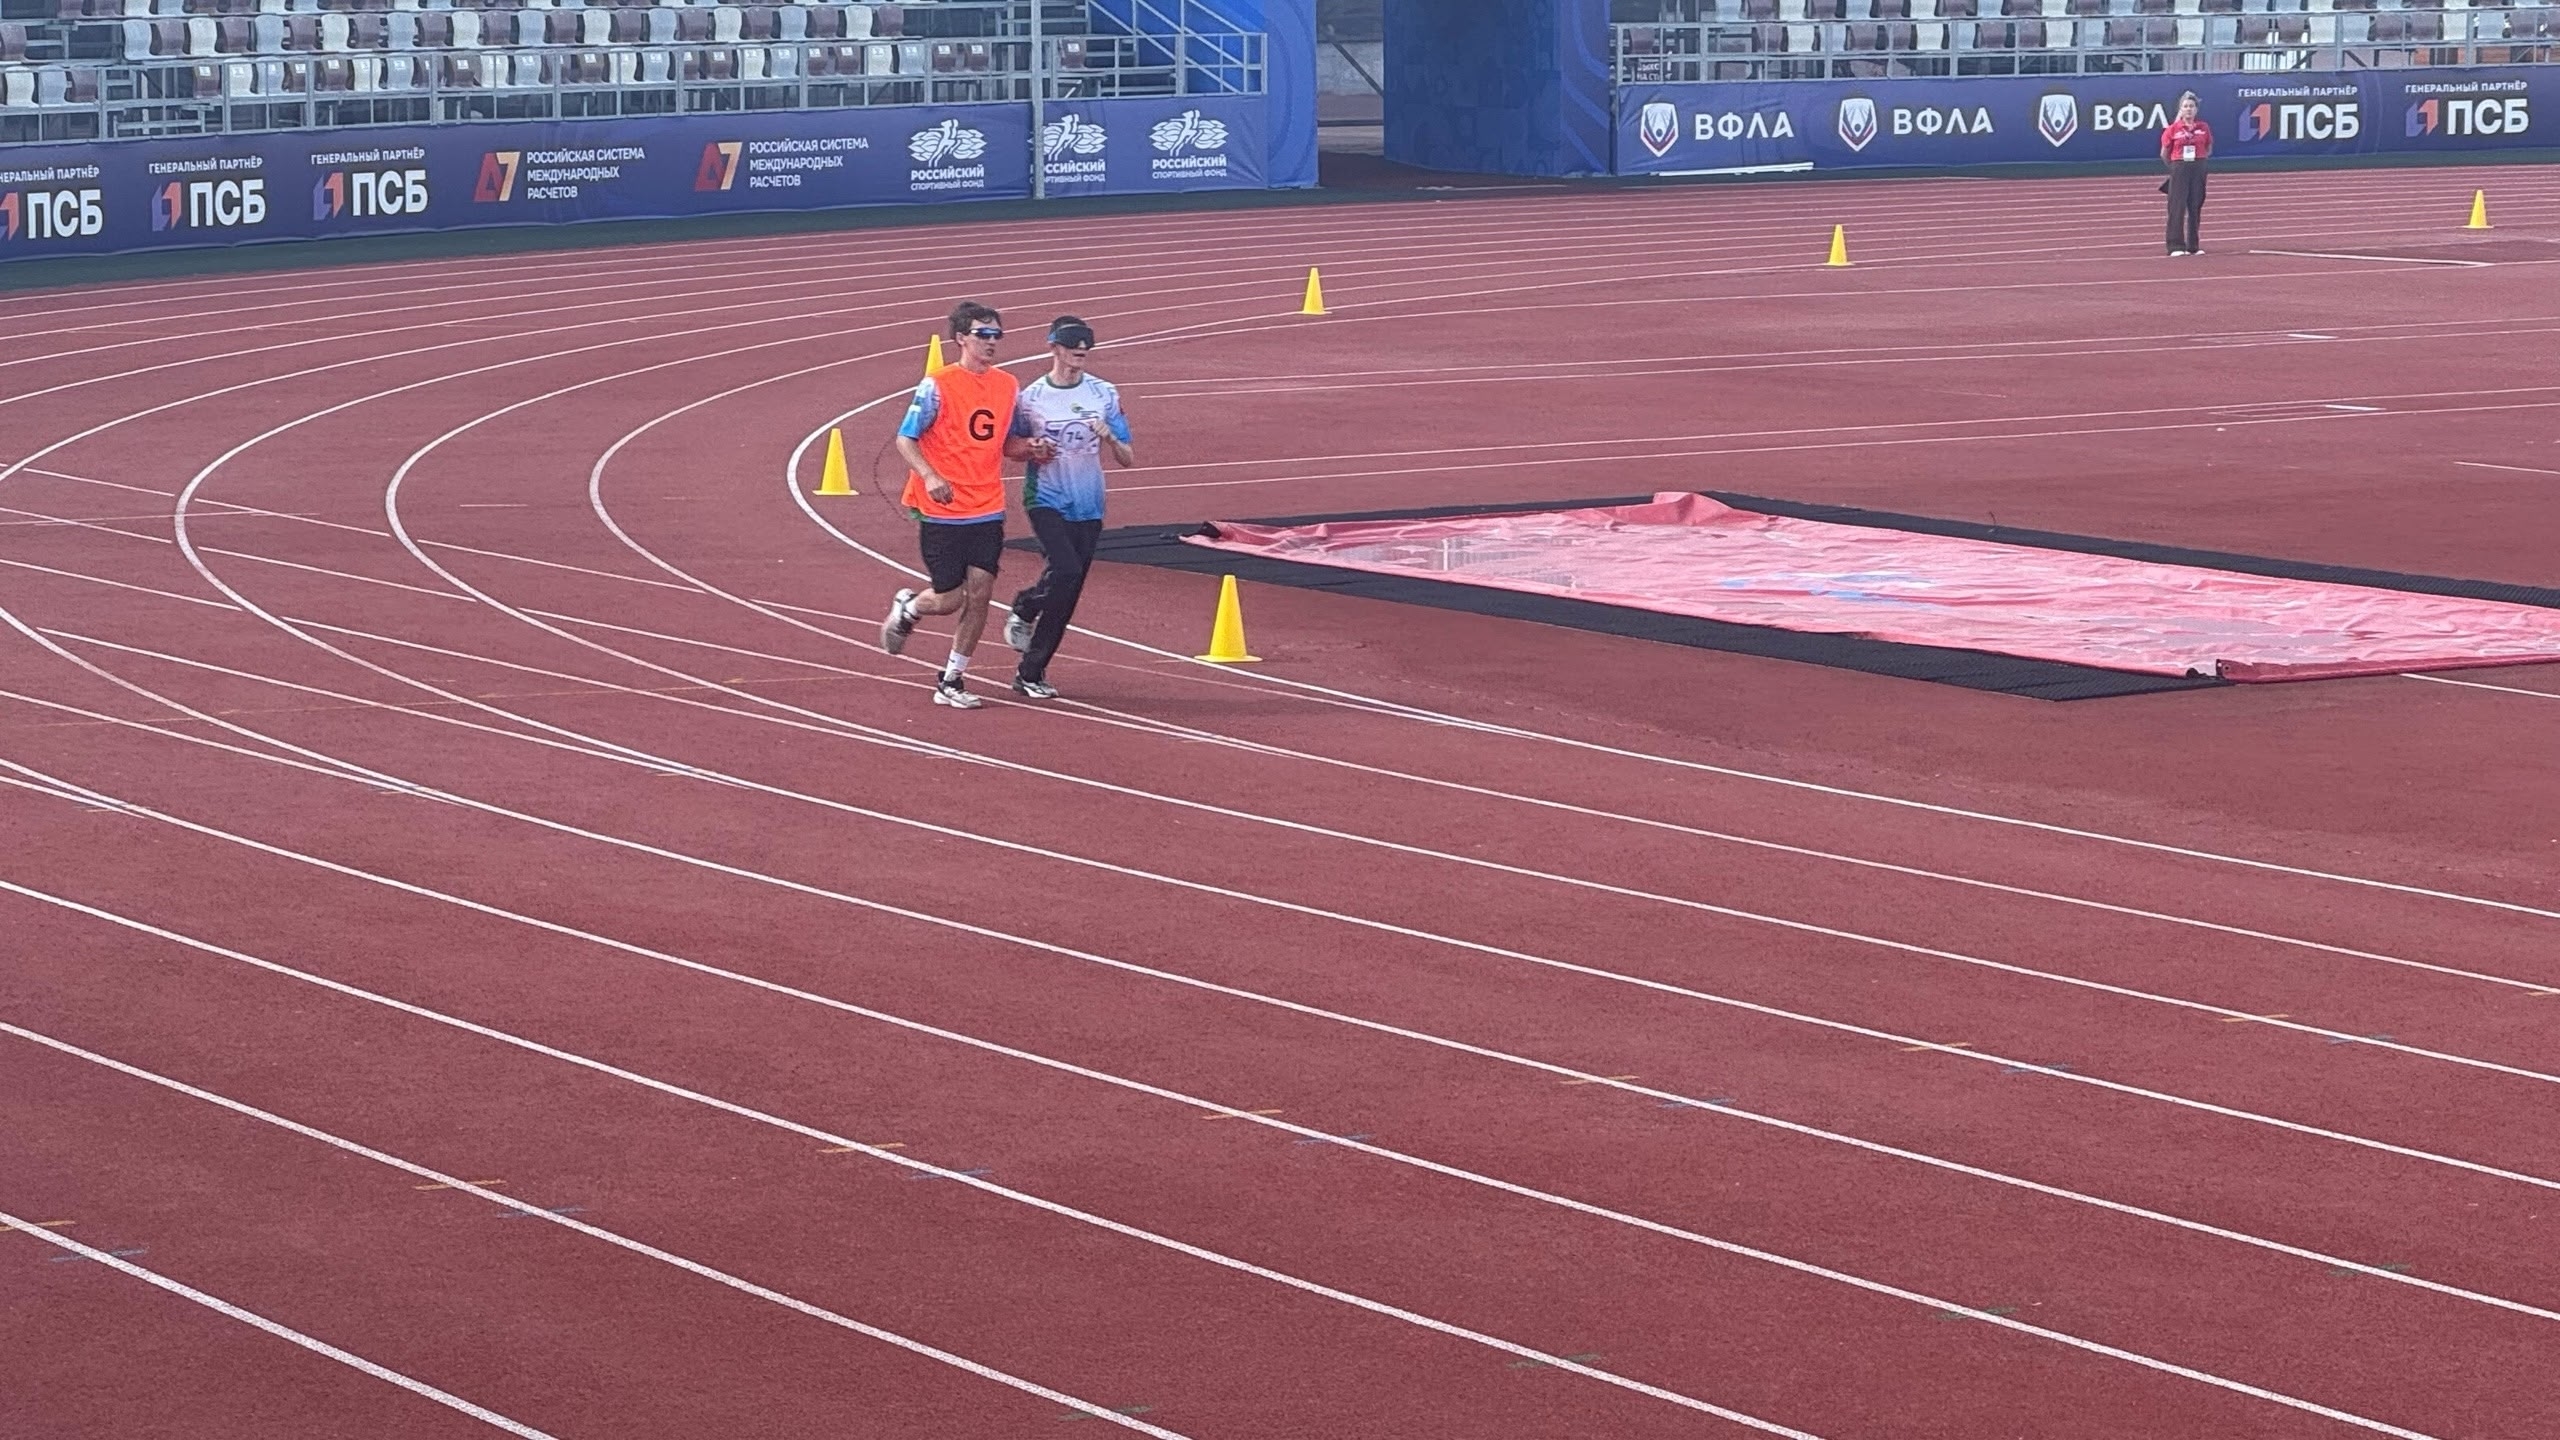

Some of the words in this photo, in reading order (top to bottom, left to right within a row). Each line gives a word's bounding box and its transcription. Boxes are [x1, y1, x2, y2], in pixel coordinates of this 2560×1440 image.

[2238, 85, 2310, 97] ГЕНЕРАЛЬНЫЙ
[2312, 84, 2358, 96] ПАРТНЁР
[2405, 82, 2478, 93] ГЕНЕРАЛЬНЫЙ
[2481, 80, 2528, 91] ПАРТНЁР
[1892, 107, 1994, 135] ВФЛА
[2094, 103, 2170, 131] ВФЛ
[2280, 103, 2359, 140] ПСБ
[2447, 98, 2529, 135] ПСБ
[1695, 111, 1794, 140] ВФЛА
[749, 138, 818, 154] РОССИЙСКАЯ
[819, 137, 869, 150] СИСТЕМА
[311, 148, 380, 165] ГЕНЕРАЛЬНЫЙ
[382, 146, 425, 160] ПАРТНЁР
[526, 148, 595, 164] РОССИЙСКАЯ
[596, 147, 645, 160] СИСТЕМА
[750, 155, 843, 172] МЕЖДУНАРОДНЫХ
[1152, 154, 1227, 169] РОССИЙСКИЙ
[56, 164, 100, 180] ПАРТНЁР
[148, 157, 217, 174] ГЕНЕРАЛЬНЫЙ
[219, 155, 263, 170] ПАРТНЁР
[911, 164, 984, 180] РОССИЙСКИЙ
[1030, 159, 1105, 174] ССИЙСКИЙ
[527, 165, 620, 183] МЕЖДУНАРОДНЫХ
[750, 174, 801, 188] РАСЧЕТОВ
[1082, 173, 1106, 182] ФОНД
[1152, 168, 1203, 179] СПОРТИВНЫЙ
[1204, 168, 1227, 177] ФОНД
[352, 169, 428, 216] ПСБ
[527, 186, 578, 199] РАСЧЕТОВ
[910, 180, 961, 191] СПОРТИВНЫЙ
[962, 179, 985, 188] ФОНД
[189, 178, 266, 228] ПСБ
[27, 188, 103, 239] ПСБ
[969, 409, 995, 441] G
[1066, 430, 1084, 443] 74
